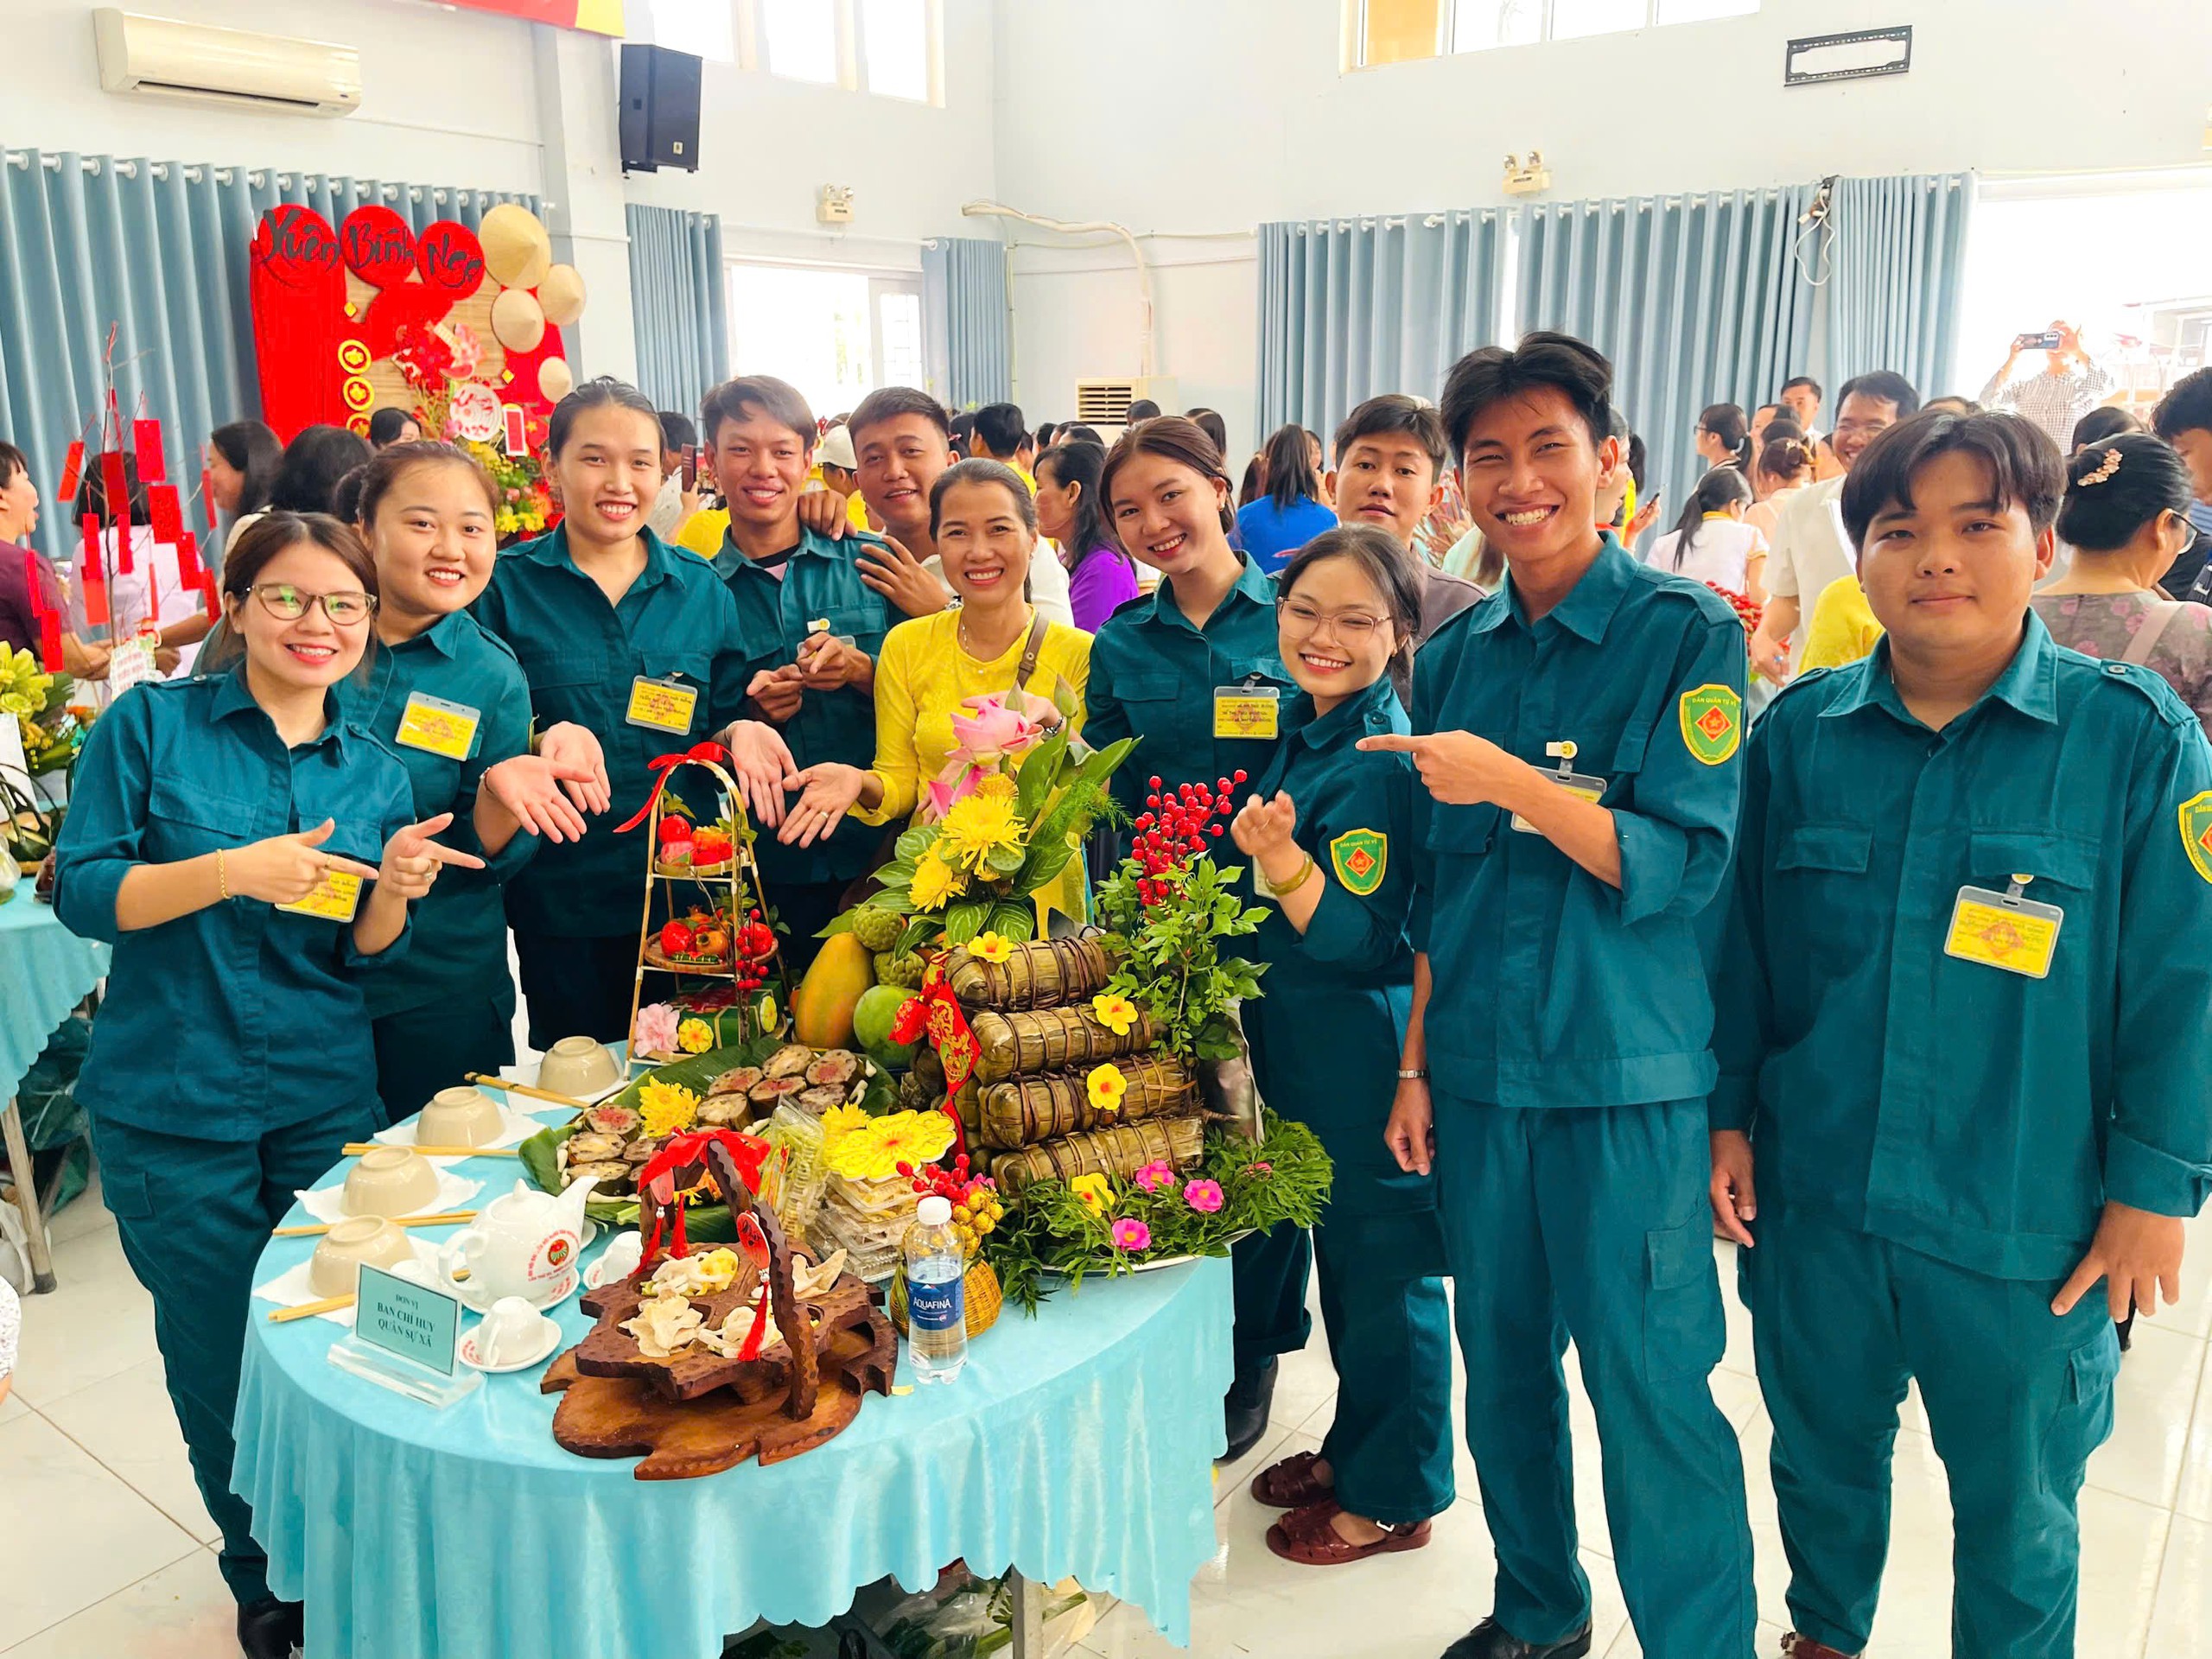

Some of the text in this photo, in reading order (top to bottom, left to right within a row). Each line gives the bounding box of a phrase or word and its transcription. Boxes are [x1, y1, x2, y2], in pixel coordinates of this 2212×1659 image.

[913, 1296, 951, 1311] AQUAFINA
[378, 1302, 395, 1316] BAN
[416, 1316, 435, 1332] HUY
[378, 1318, 403, 1336] QUÂN
